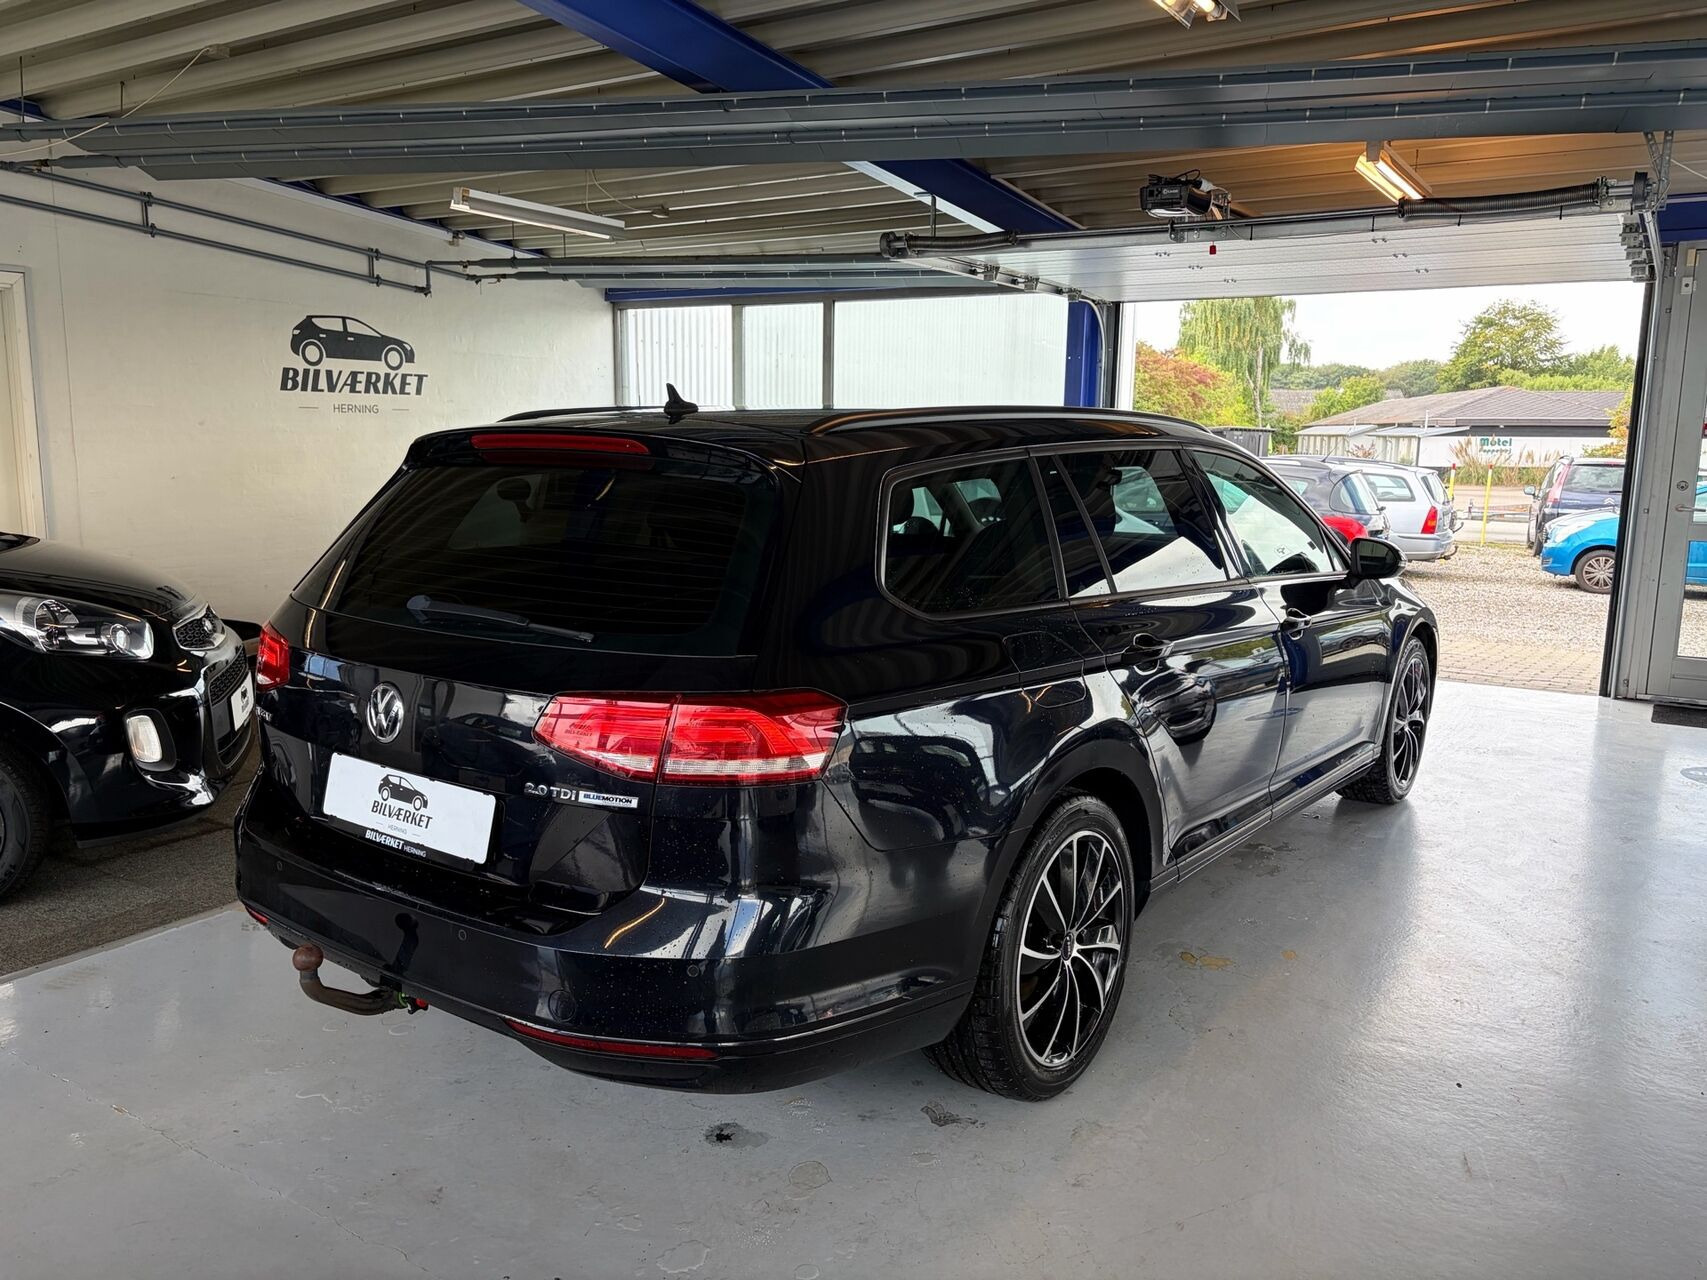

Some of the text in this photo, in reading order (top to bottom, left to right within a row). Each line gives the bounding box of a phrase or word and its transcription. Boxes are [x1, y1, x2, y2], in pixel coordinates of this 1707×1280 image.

[280, 367, 428, 395] BILVÆRKET
[333, 403, 379, 414] HERNING
[583, 793, 632, 805] BLUEMOTION
[372, 801, 432, 829] BILVÆRKET
[366, 830, 426, 857] BILVÆRKET HERNING
